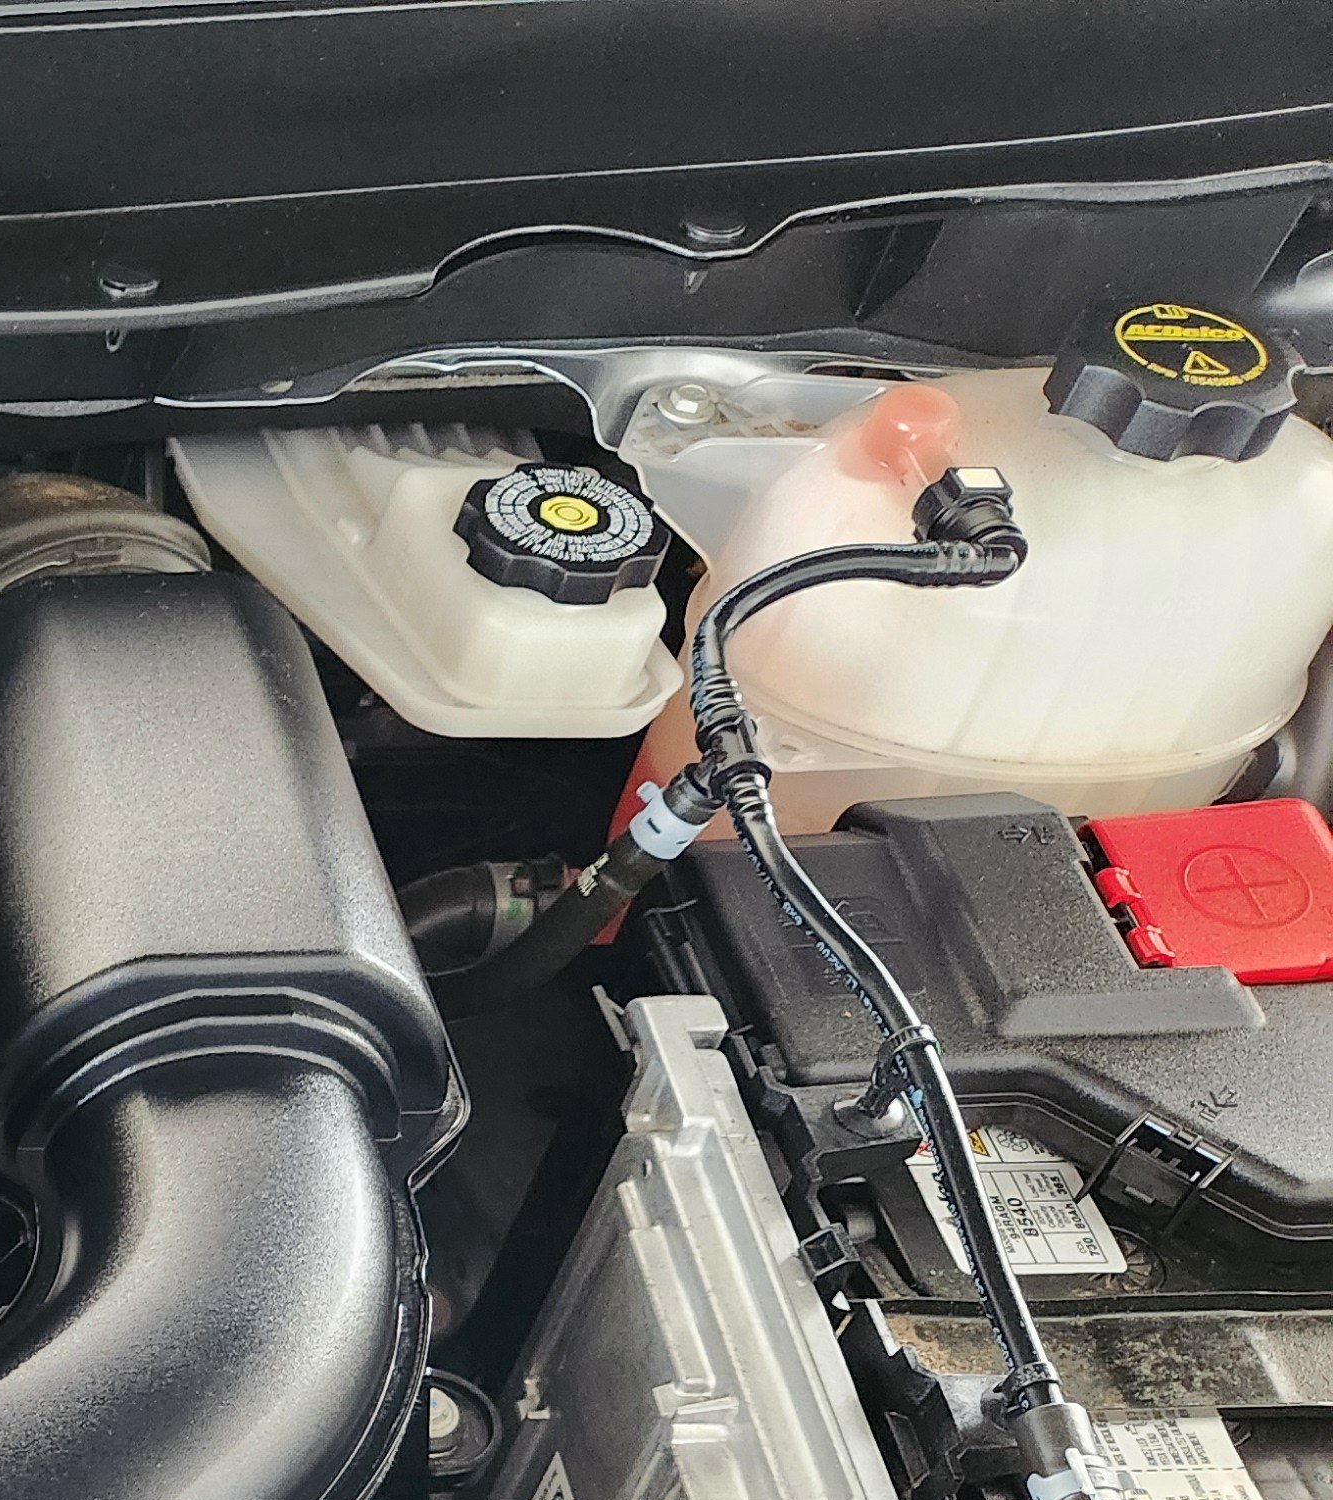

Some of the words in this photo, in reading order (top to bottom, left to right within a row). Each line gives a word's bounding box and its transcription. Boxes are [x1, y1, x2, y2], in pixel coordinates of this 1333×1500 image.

[1049, 1176, 1067, 1194] 365
[1005, 1197, 1040, 1236] 8540
[1063, 1203, 1085, 1228] 80Ah
[1082, 1237, 1100, 1255] 730
